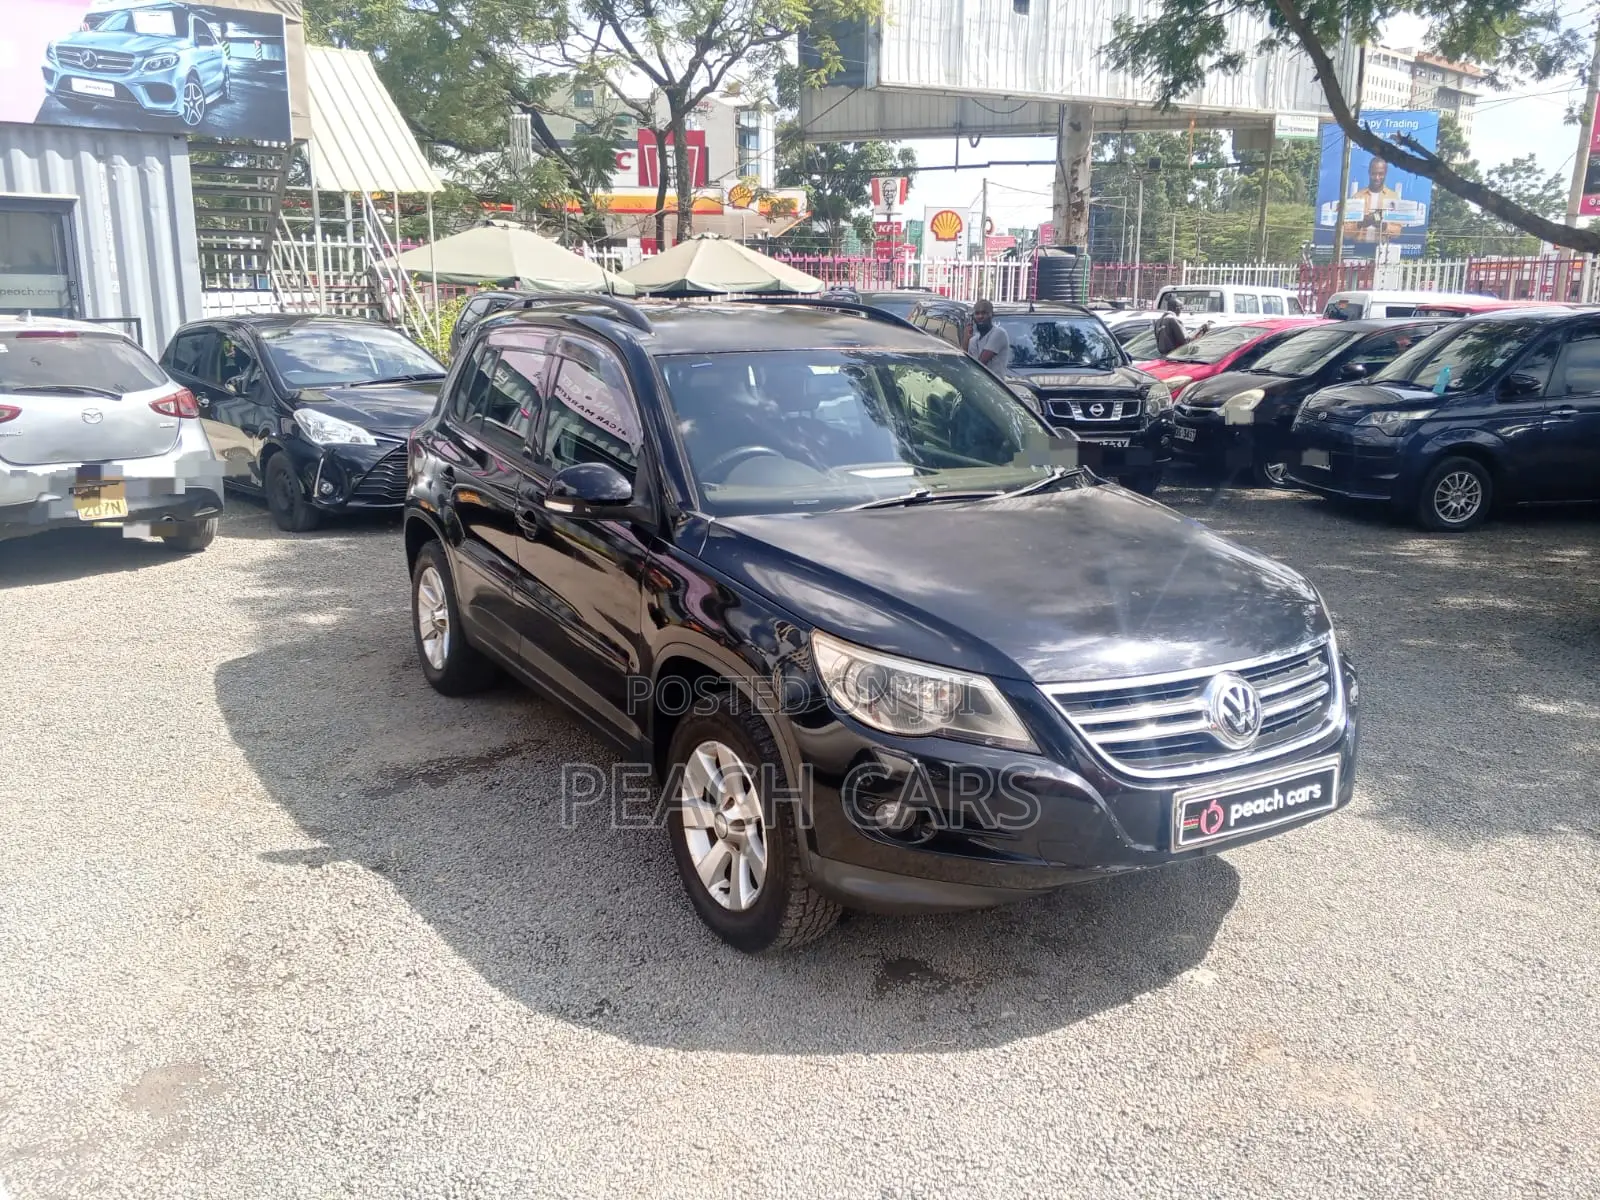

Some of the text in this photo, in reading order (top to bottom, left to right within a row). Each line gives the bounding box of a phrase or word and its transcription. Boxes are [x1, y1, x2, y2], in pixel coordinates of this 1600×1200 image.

[1385, 119, 1419, 130] Trading
[878, 224, 901, 233] KFC
[1230, 783, 1322, 827] peach cars
